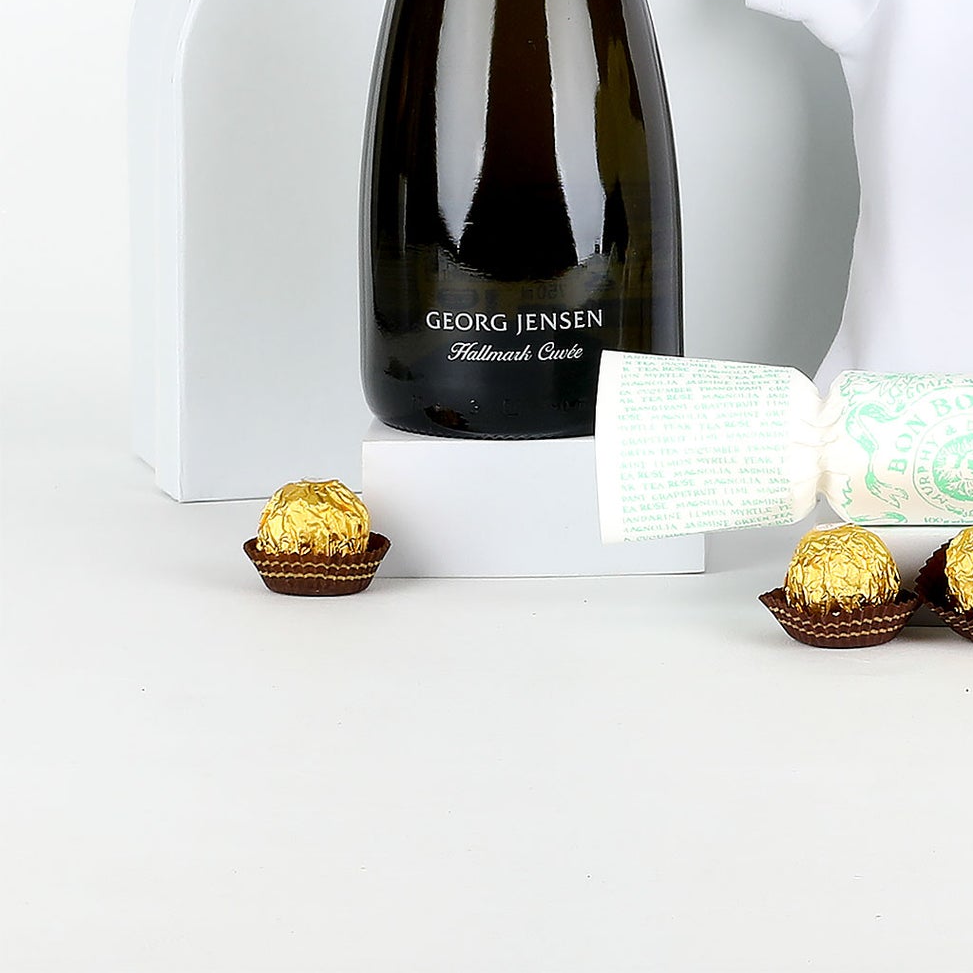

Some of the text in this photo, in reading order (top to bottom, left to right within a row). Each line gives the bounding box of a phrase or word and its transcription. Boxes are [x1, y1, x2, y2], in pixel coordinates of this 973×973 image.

[426, 309, 603, 336] GEORG JENSEN
[447, 341, 584, 362] Hallmark Cuvée
[887, 414, 927, 475] BON
[917, 435, 948, 506] MURPHY
[945, 424, 958, 436] &
